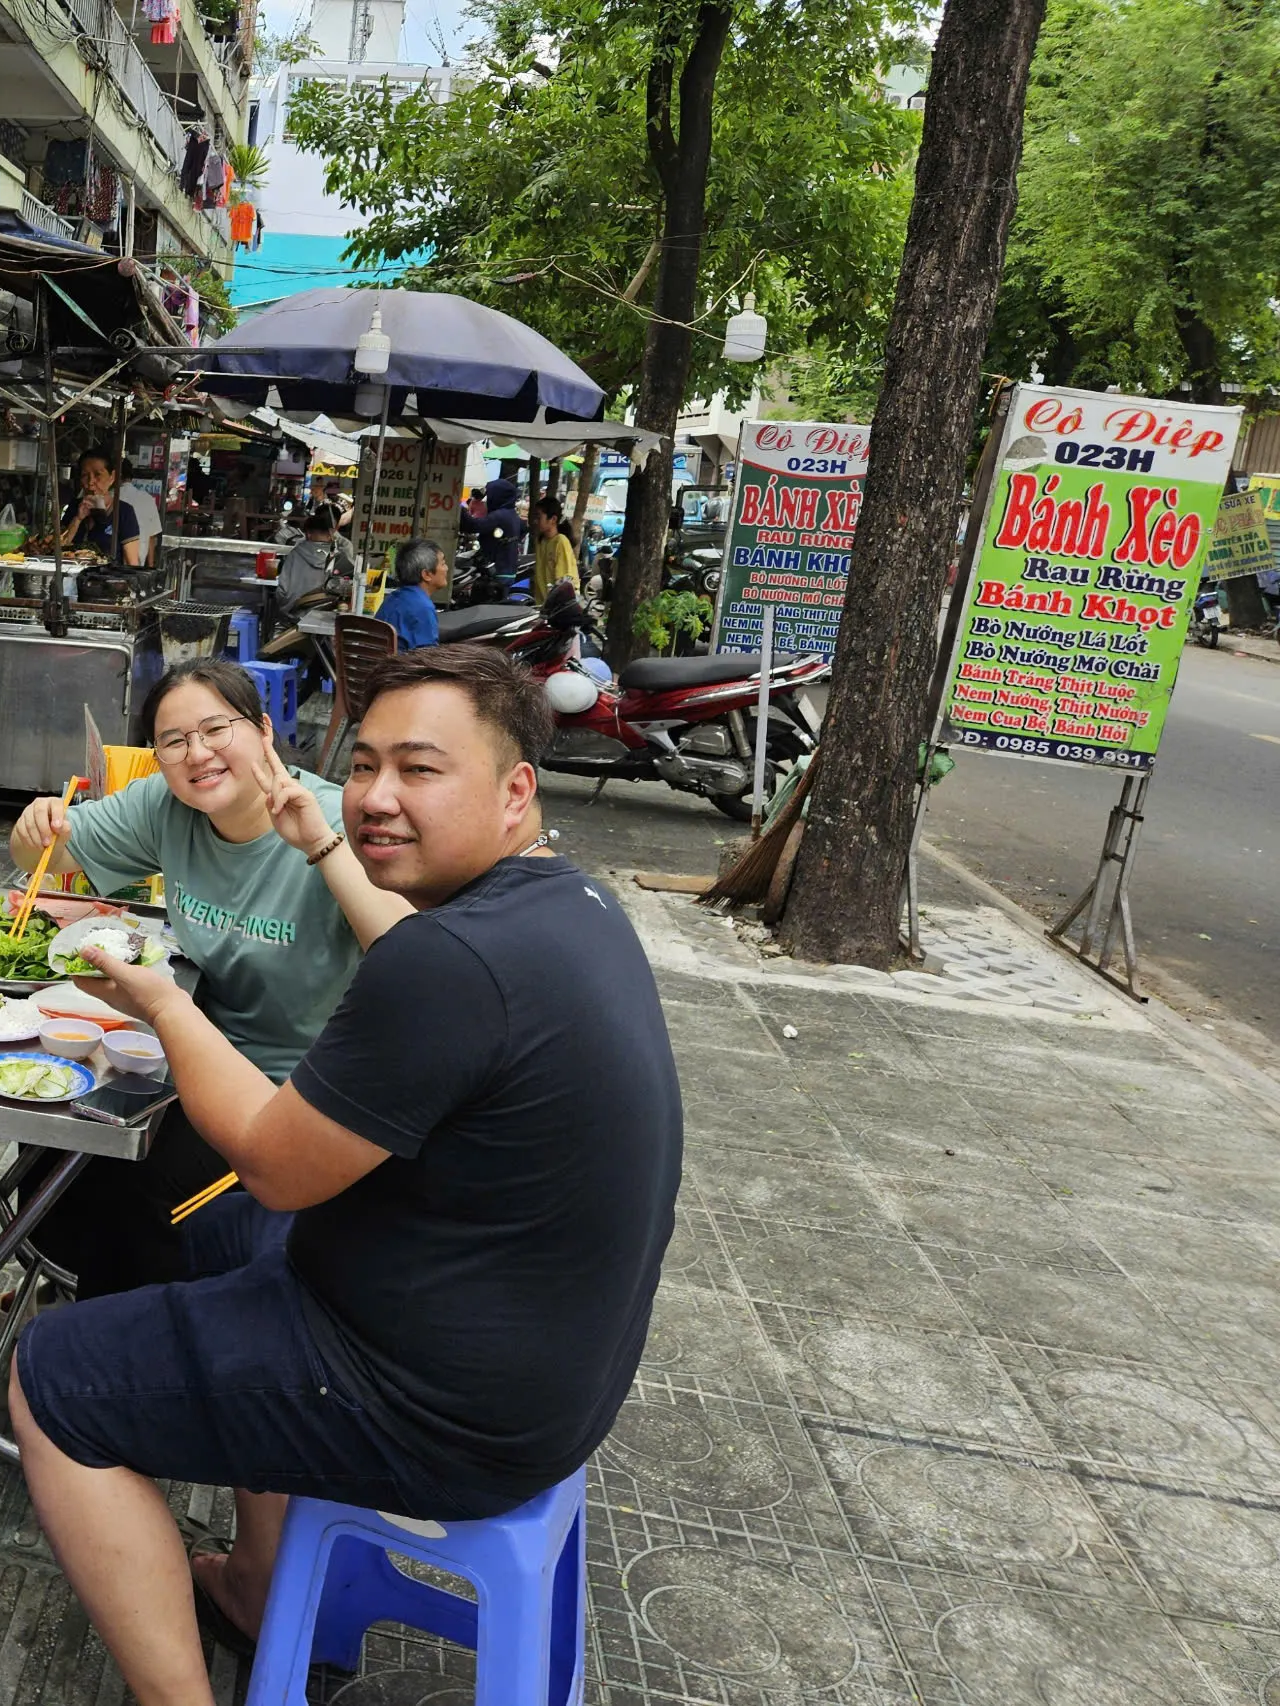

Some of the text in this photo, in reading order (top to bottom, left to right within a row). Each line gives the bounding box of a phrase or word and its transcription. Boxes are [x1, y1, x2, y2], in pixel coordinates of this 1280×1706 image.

[756, 425, 795, 451] Cô
[1024, 398, 1225, 458] Cô Điệp
[787, 457, 847, 474] 023H
[1054, 441, 1155, 472] 023H
[380, 470, 402, 480] 026
[739, 474, 863, 533] BÁNH XÈ
[1245, 495, 1255, 505] XE
[996, 473, 1201, 570] Bánh Xèo
[757, 530, 854, 550] RAU RỪNG
[734, 544, 801, 570] BÁNH
[750, 570, 766, 584] BÒ
[810, 576, 824, 589] LÁ
[1024, 557, 1089, 584] Rau
[1099, 566, 1186, 600] Rừng
[742, 586, 759, 599] BÒ
[730, 601, 761, 615] BÁNH
[803, 608, 828, 622] THỊT
[978, 581, 1177, 631] Bánh Khọt
[723, 617, 749, 629] NEM
[795, 623, 820, 637] THỊT
[974, 617, 1148, 654] Bò Nướng Lá Lốt
[726, 632, 752, 645] NEM
[799, 637, 831, 653] BÁNH
[968, 641, 1160, 681] Bò Nướng Mỡ Chài
[960, 664, 1136, 703] Bánh Tráng Thịt Luộc
[955, 685, 992, 702] Nem
[1057, 697, 1093, 718] Thịt
[1096, 703, 1149, 725] Nướng
[951, 705, 987, 723] Nem
[990, 710, 1023, 728] Cua
[1055, 719, 1096, 738] Bánh
[995, 735, 1050, 755] 0985
[1056, 744, 1096, 761] 039
